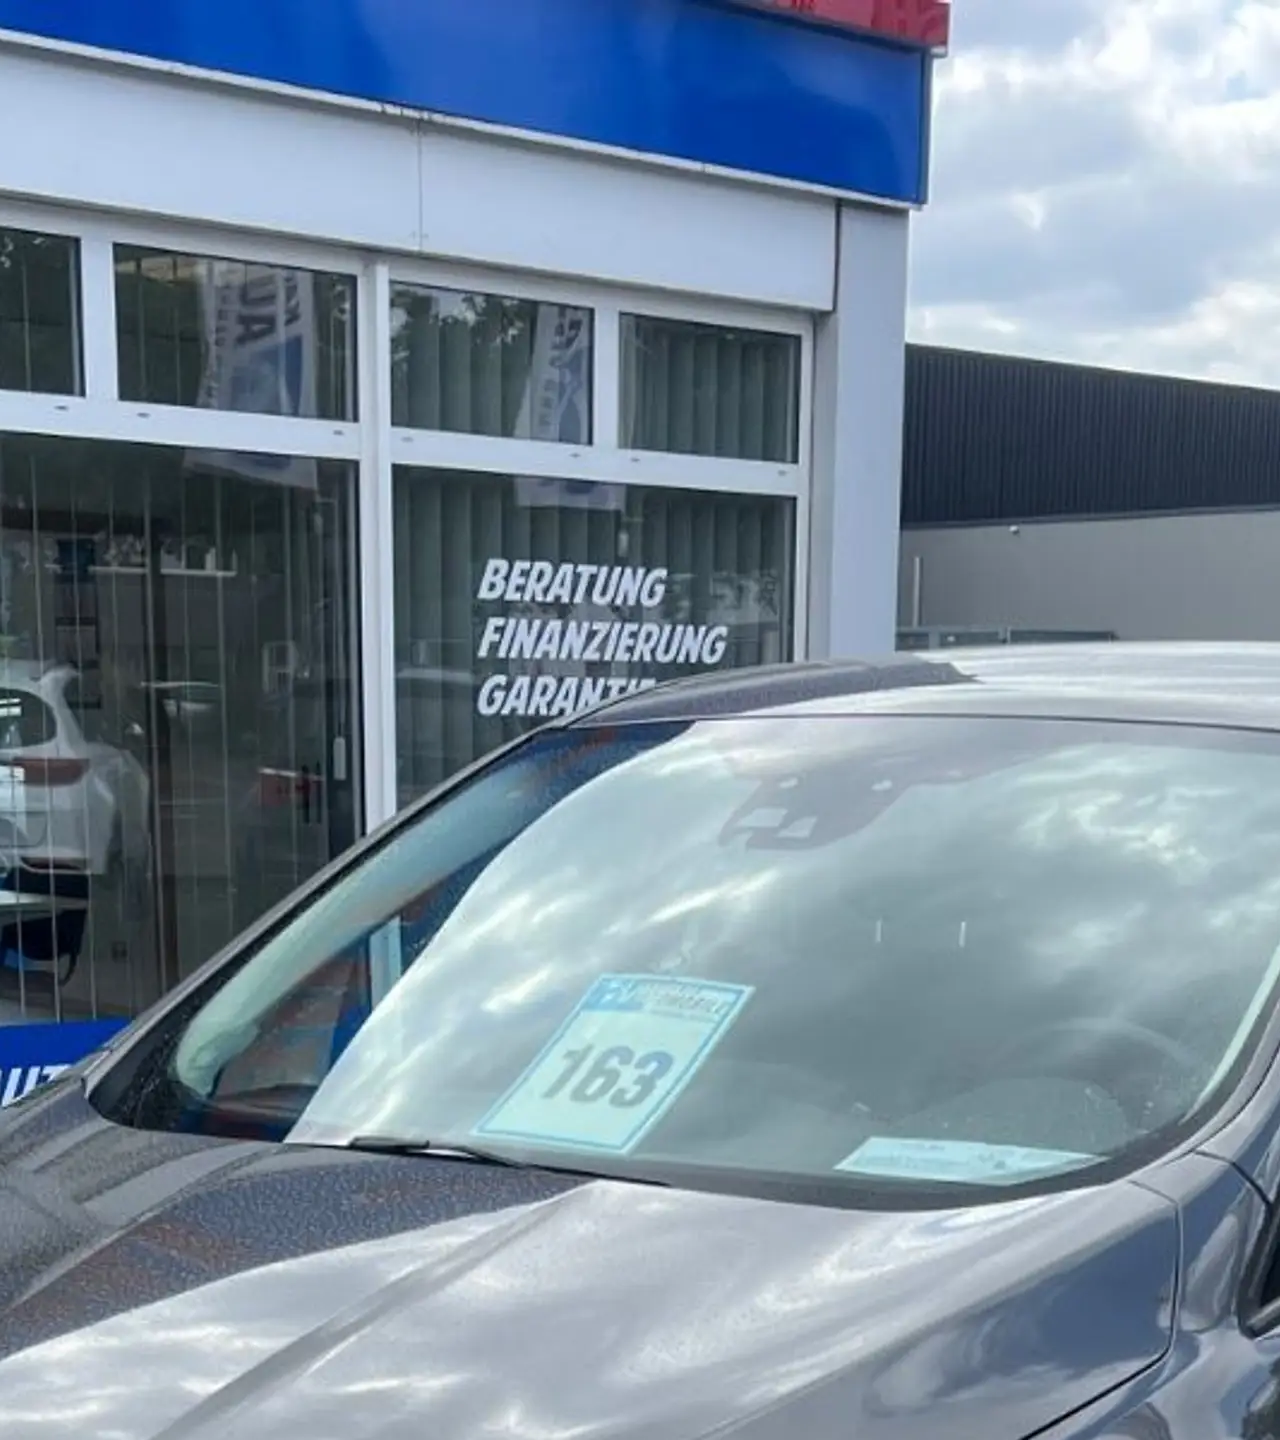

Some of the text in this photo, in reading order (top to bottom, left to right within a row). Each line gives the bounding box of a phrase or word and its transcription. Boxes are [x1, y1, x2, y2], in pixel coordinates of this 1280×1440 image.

[477, 557, 668, 608] BERATUNG
[477, 616, 729, 665] FINANZIERUNG
[541, 1044, 674, 1109] 163
